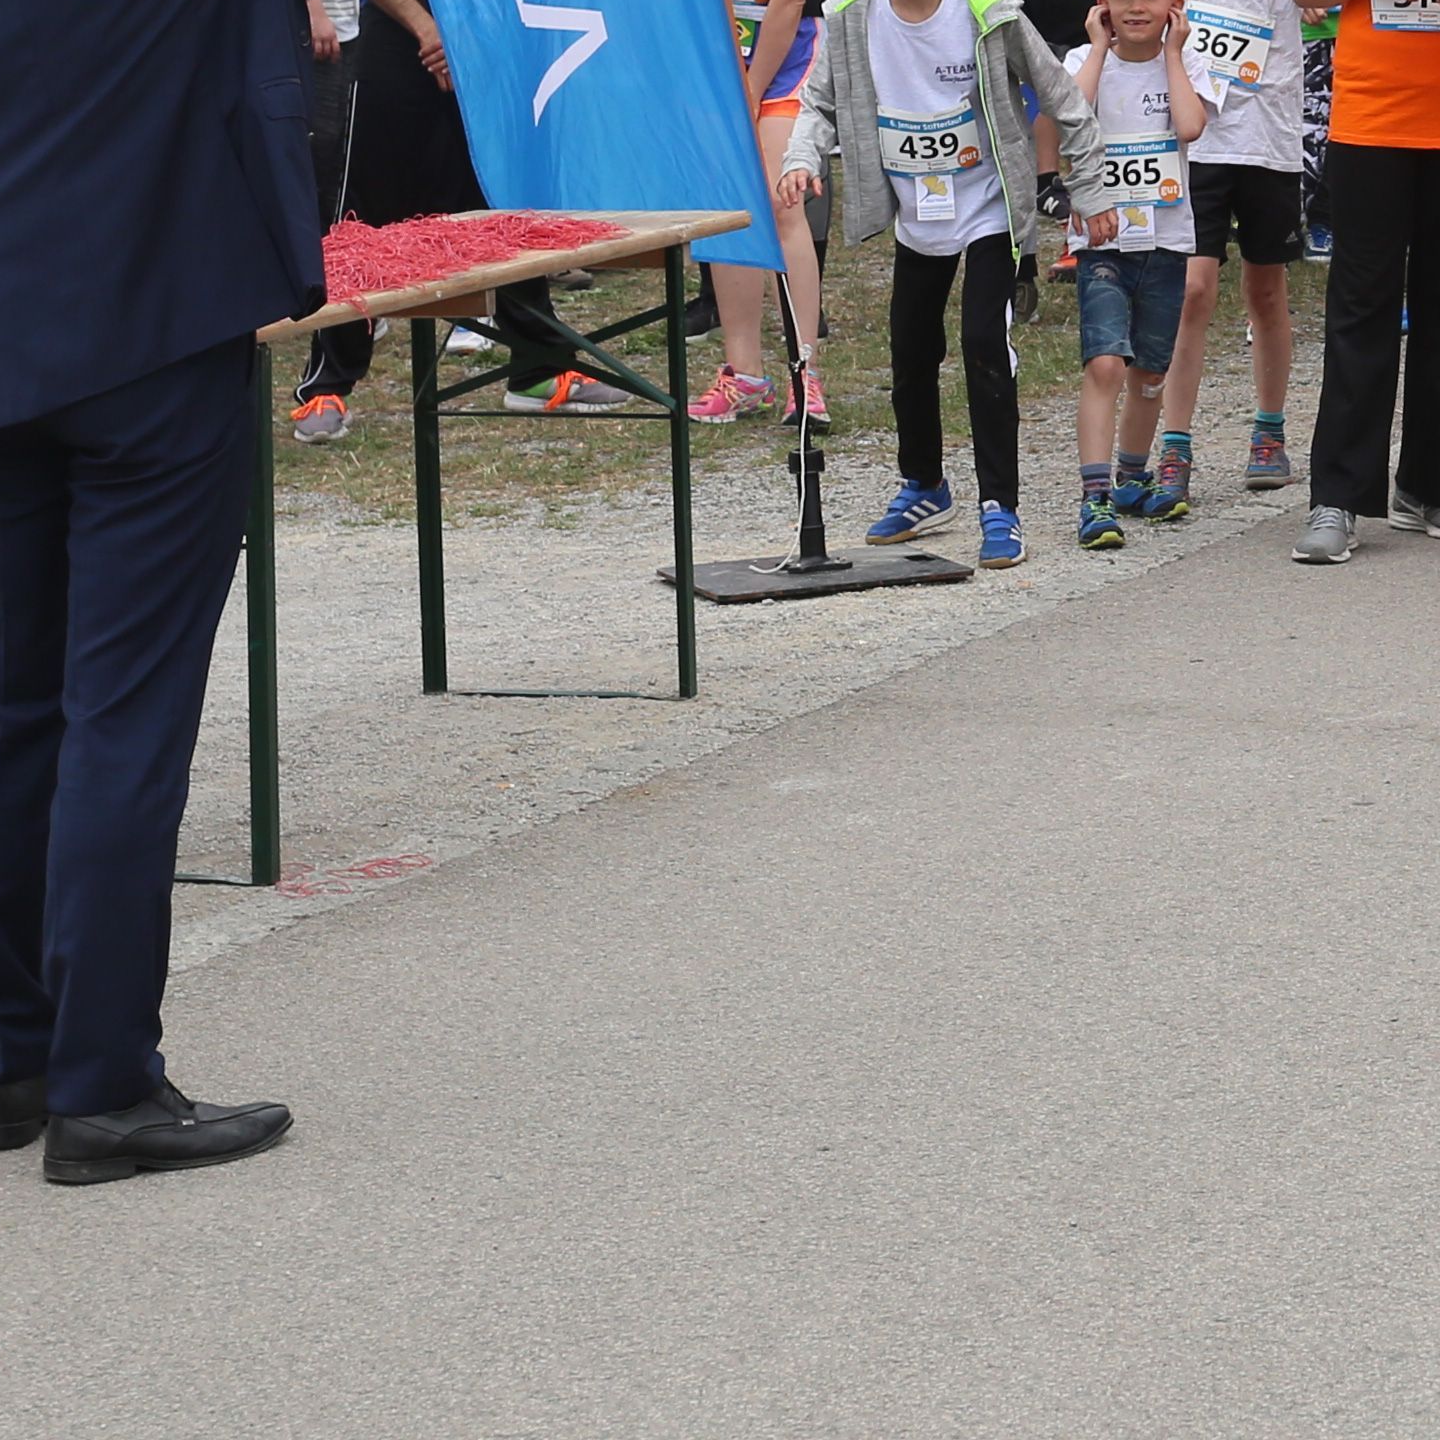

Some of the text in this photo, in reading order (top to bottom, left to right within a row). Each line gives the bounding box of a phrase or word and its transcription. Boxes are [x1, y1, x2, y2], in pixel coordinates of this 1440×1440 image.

[1223, 18, 1261, 35] Stifterlauf
[1193, 28, 1251, 61] 367
[1239, 67, 1259, 79] gut
[922, 116, 962, 131] Stifterlauf
[899, 132, 959, 160] 439
[1127, 141, 1167, 154] Stifterlauf
[959, 151, 978, 164] gut
[1103, 158, 1162, 188] 365
[1160, 184, 1178, 197] gut
